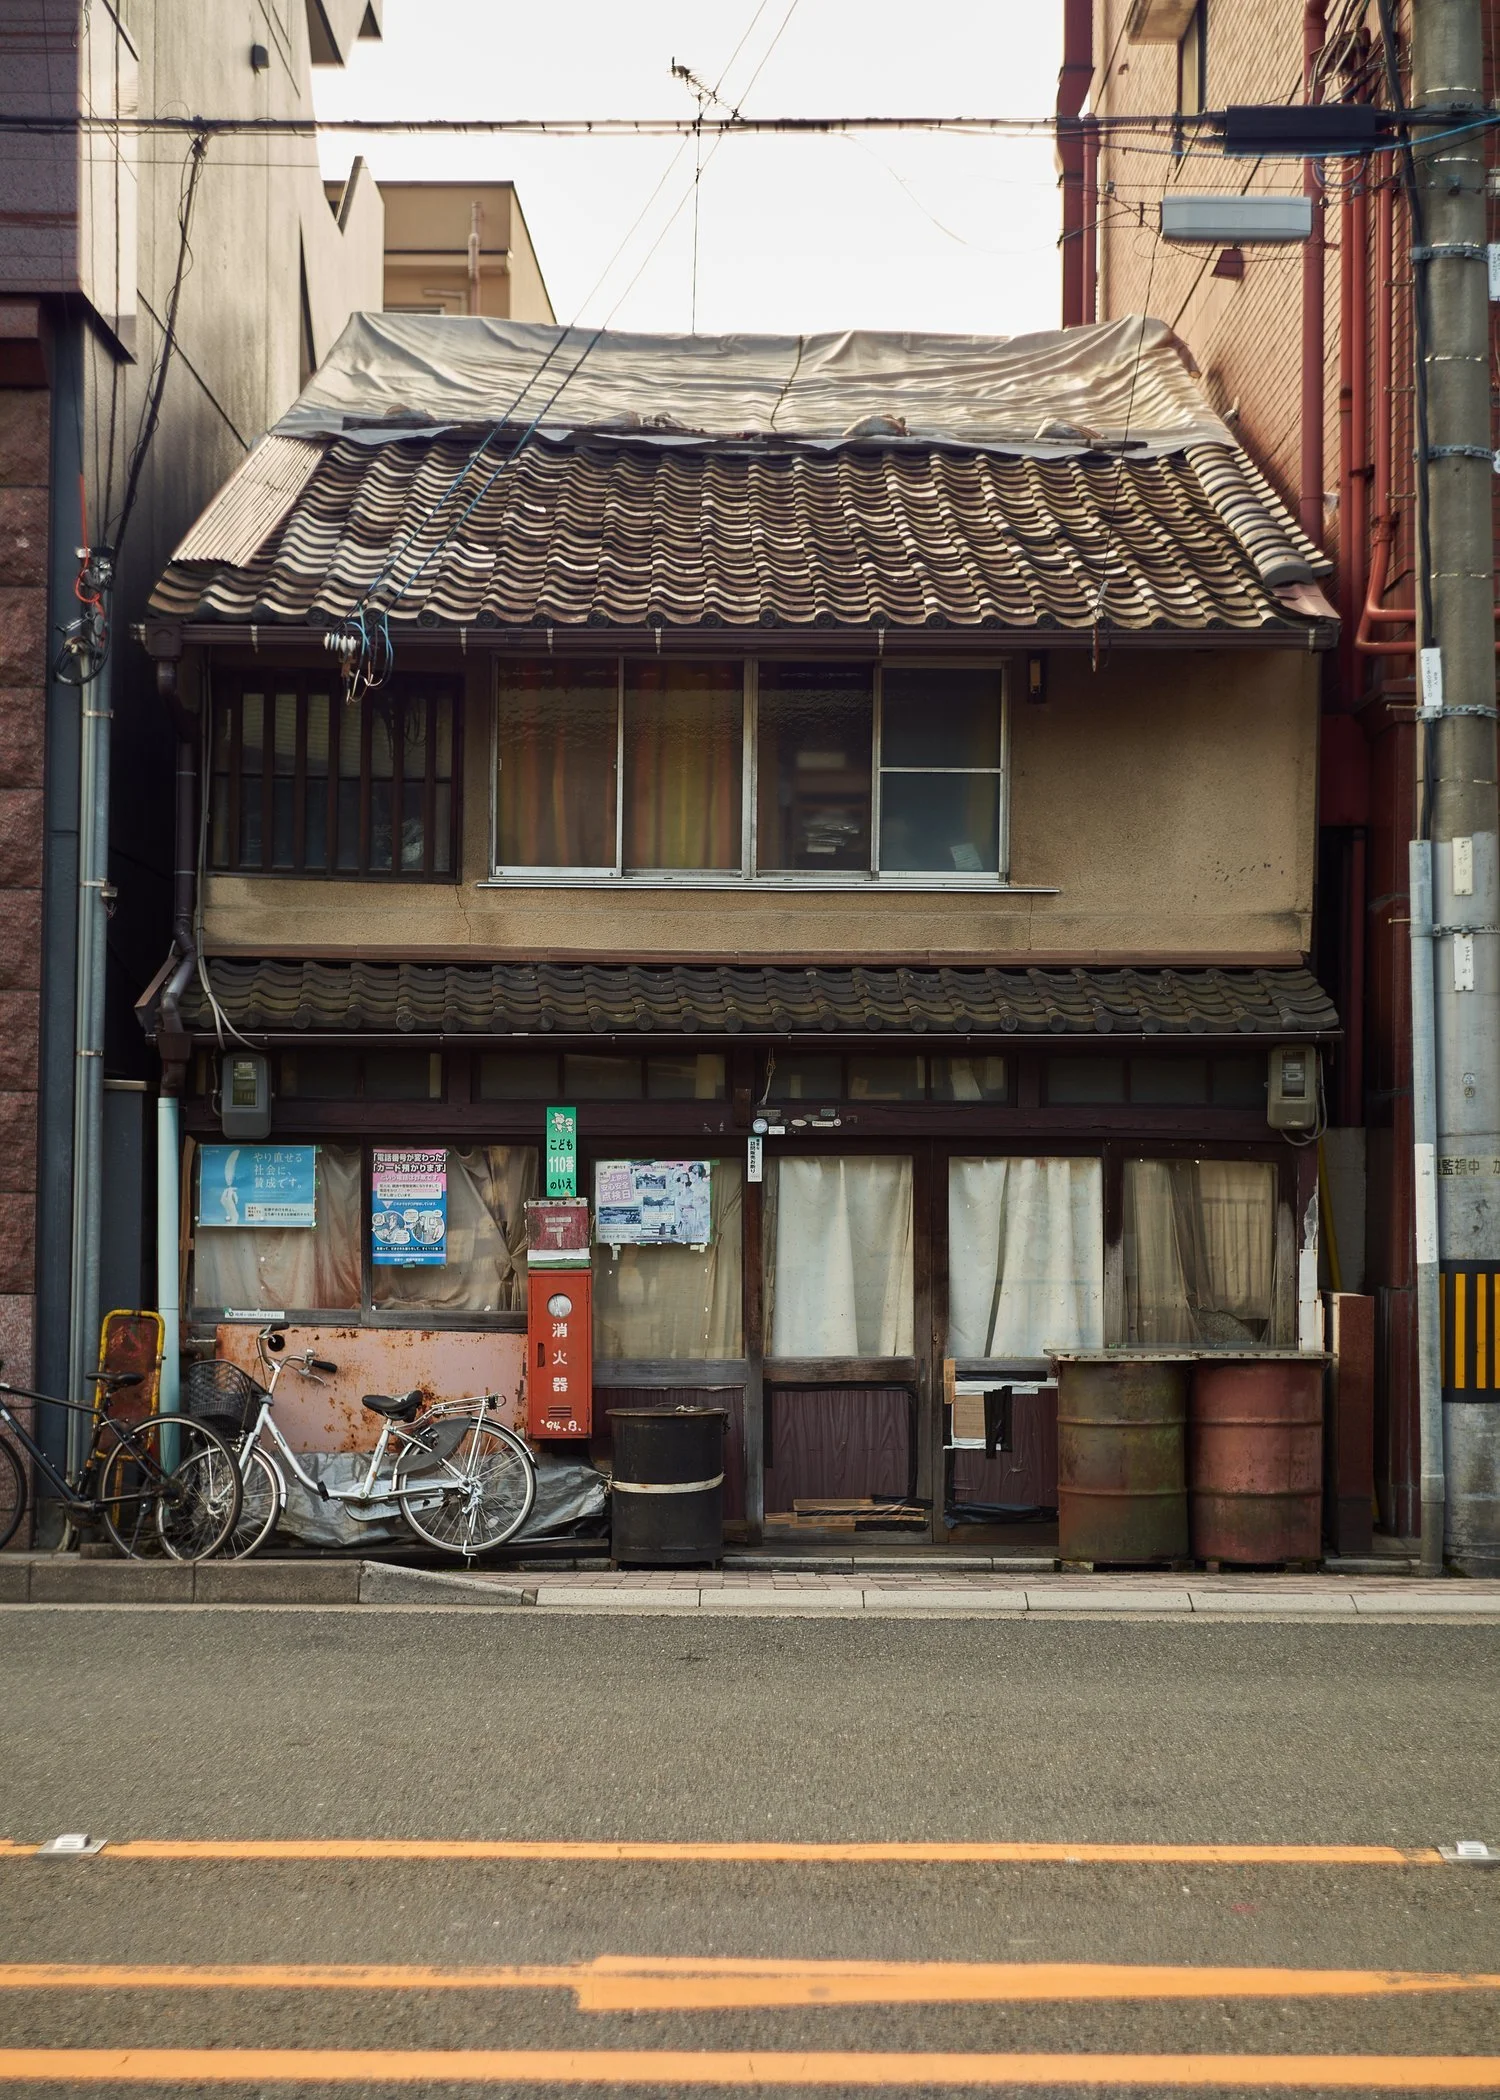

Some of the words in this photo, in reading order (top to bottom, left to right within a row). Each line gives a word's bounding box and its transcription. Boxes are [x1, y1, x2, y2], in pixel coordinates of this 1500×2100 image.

[549, 1138, 573, 1151] こども
[253, 1151, 303, 1163] やり直せる
[373, 1153, 447, 1163] 「電話番号が変わった」
[254, 1164, 292, 1176] 社会に、
[373, 1163, 447, 1173] 「カード預かります」
[548, 1156, 575, 1173] 110番
[254, 1177, 302, 1189] 賛成です。
[549, 1178, 573, 1190] のいえ
[602, 1189, 631, 1202] 点検日
[552, 1322, 568, 1392] 消火器
